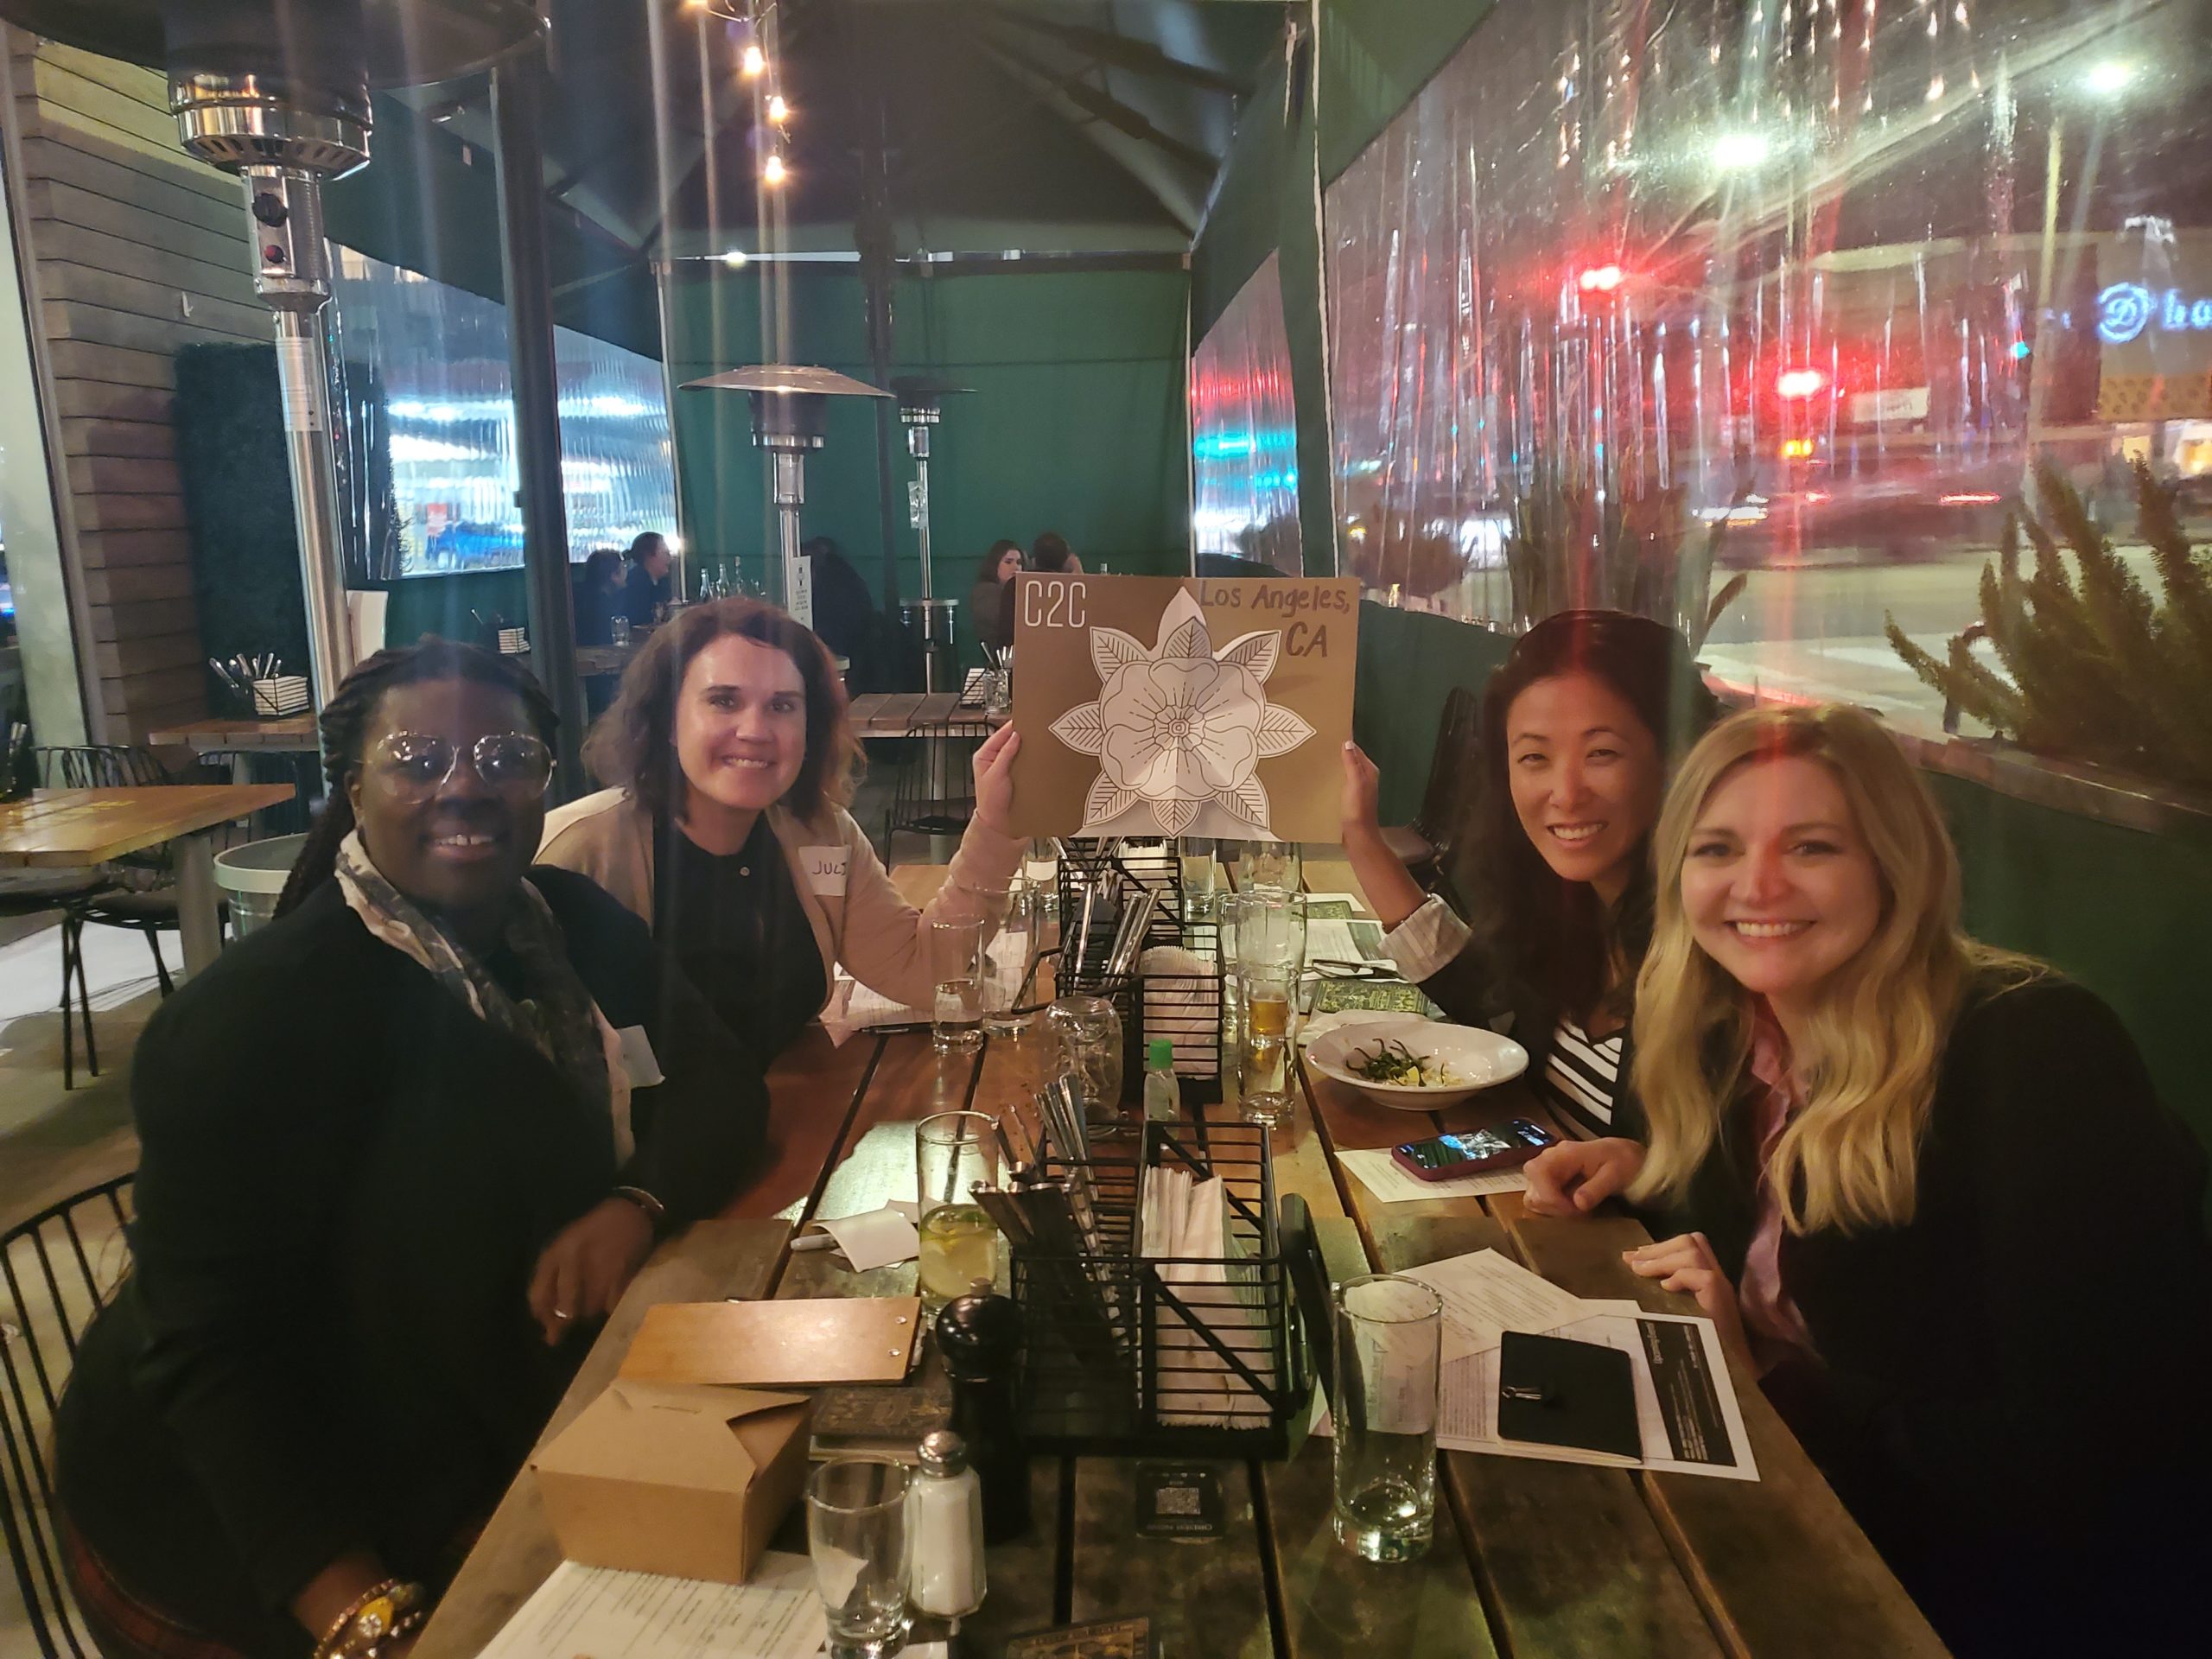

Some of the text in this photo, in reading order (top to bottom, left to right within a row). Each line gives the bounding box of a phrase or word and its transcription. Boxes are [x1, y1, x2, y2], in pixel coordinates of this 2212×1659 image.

[1025, 580, 1086, 628] C2C
[1200, 580, 1241, 607] Los
[1286, 621, 1327, 658] CA
